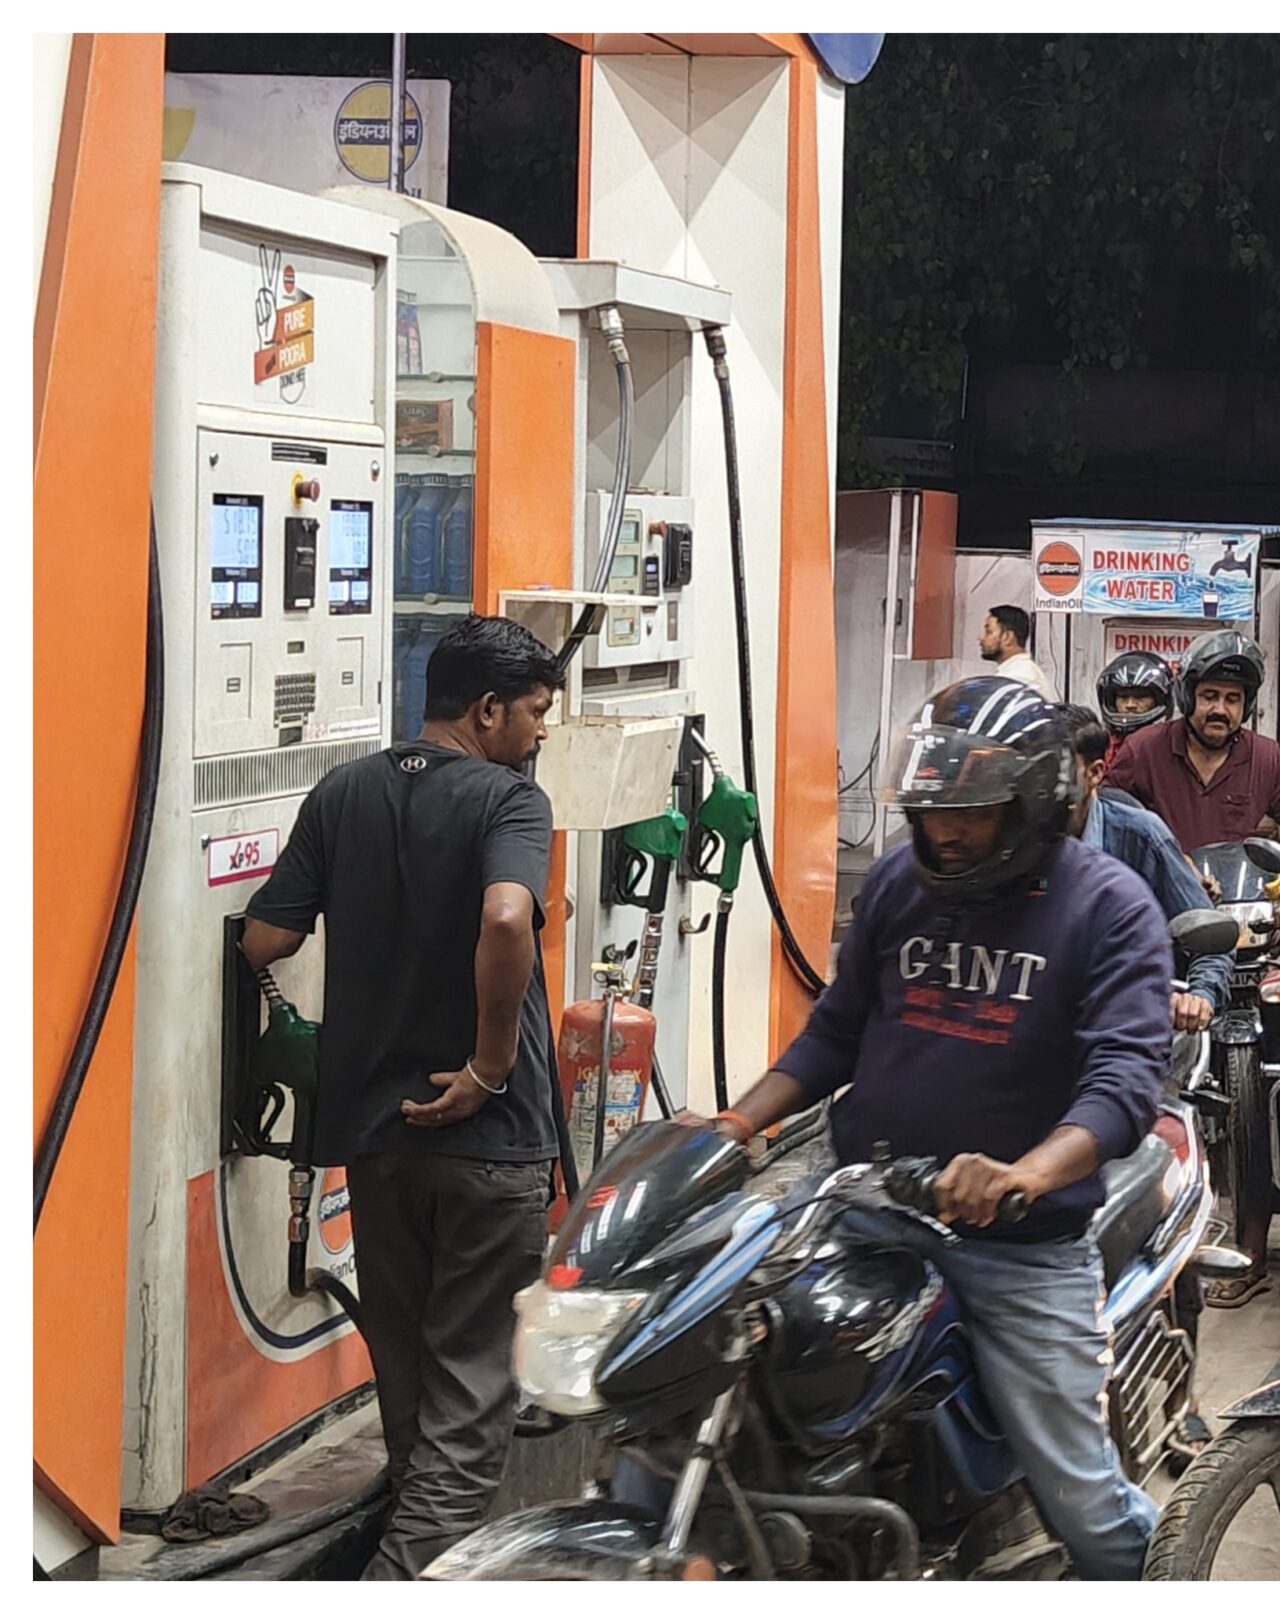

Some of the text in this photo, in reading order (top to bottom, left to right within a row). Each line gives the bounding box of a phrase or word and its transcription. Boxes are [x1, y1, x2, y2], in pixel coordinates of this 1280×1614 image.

[284, 306, 306, 334] PURE
[1093, 550, 1190, 572] DRINKING
[1106, 579, 1175, 600] WATER
[1036, 598, 1083, 609] IndianOil
[1115, 633, 1197, 652] DRINKIN
[900, 936, 1047, 1001] GANT
